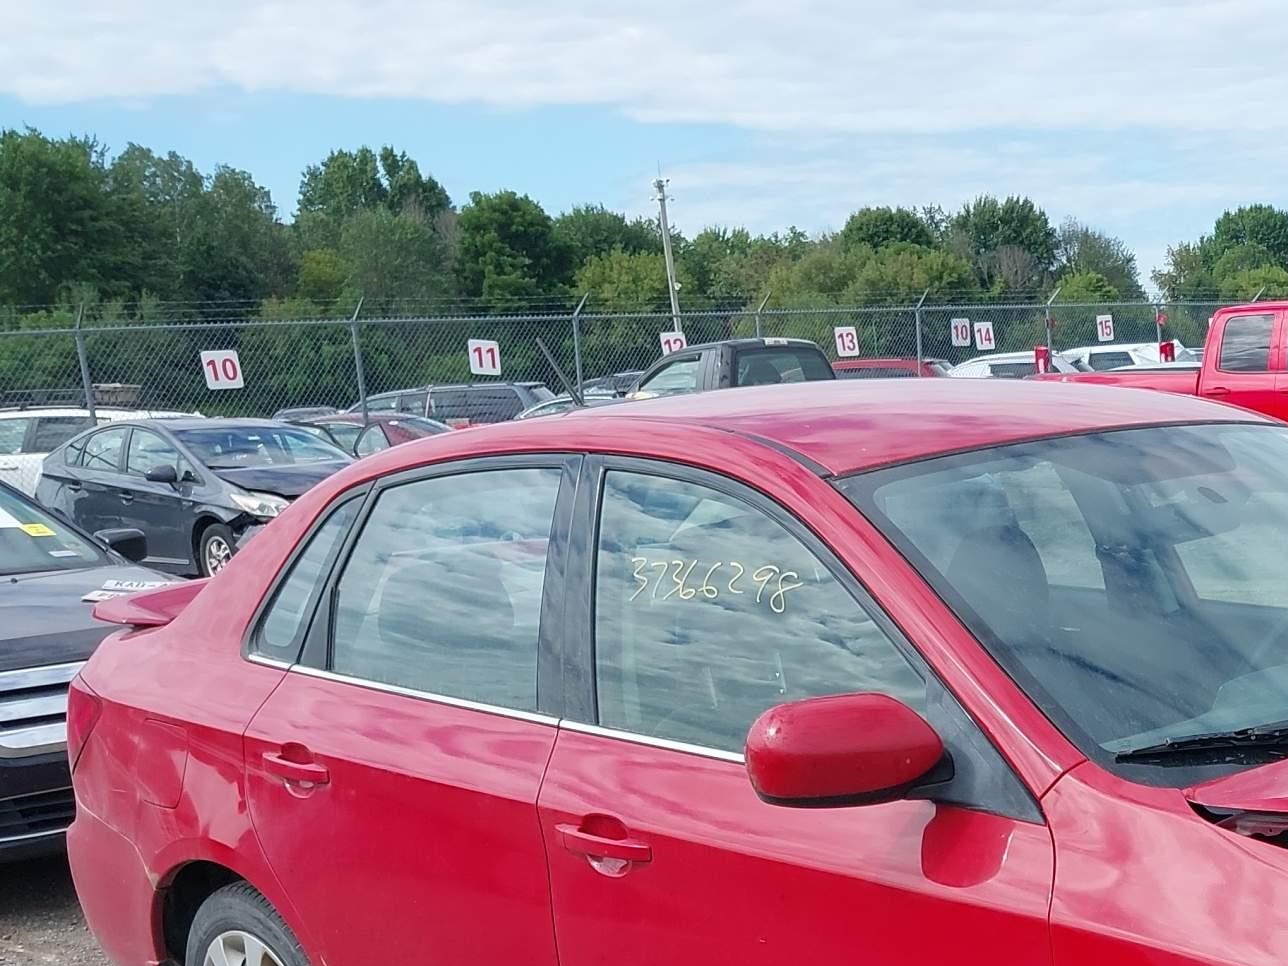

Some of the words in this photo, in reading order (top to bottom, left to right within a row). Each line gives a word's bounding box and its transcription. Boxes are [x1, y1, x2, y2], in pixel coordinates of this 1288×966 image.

[953, 324, 968, 341] 10
[976, 327, 992, 345] 14
[1099, 320, 1112, 337] 15
[664, 338, 685, 353] 12
[837, 332, 856, 352] 13
[473, 346, 497, 369] 11
[206, 358, 238, 382] 10
[629, 557, 805, 613] 37366298
